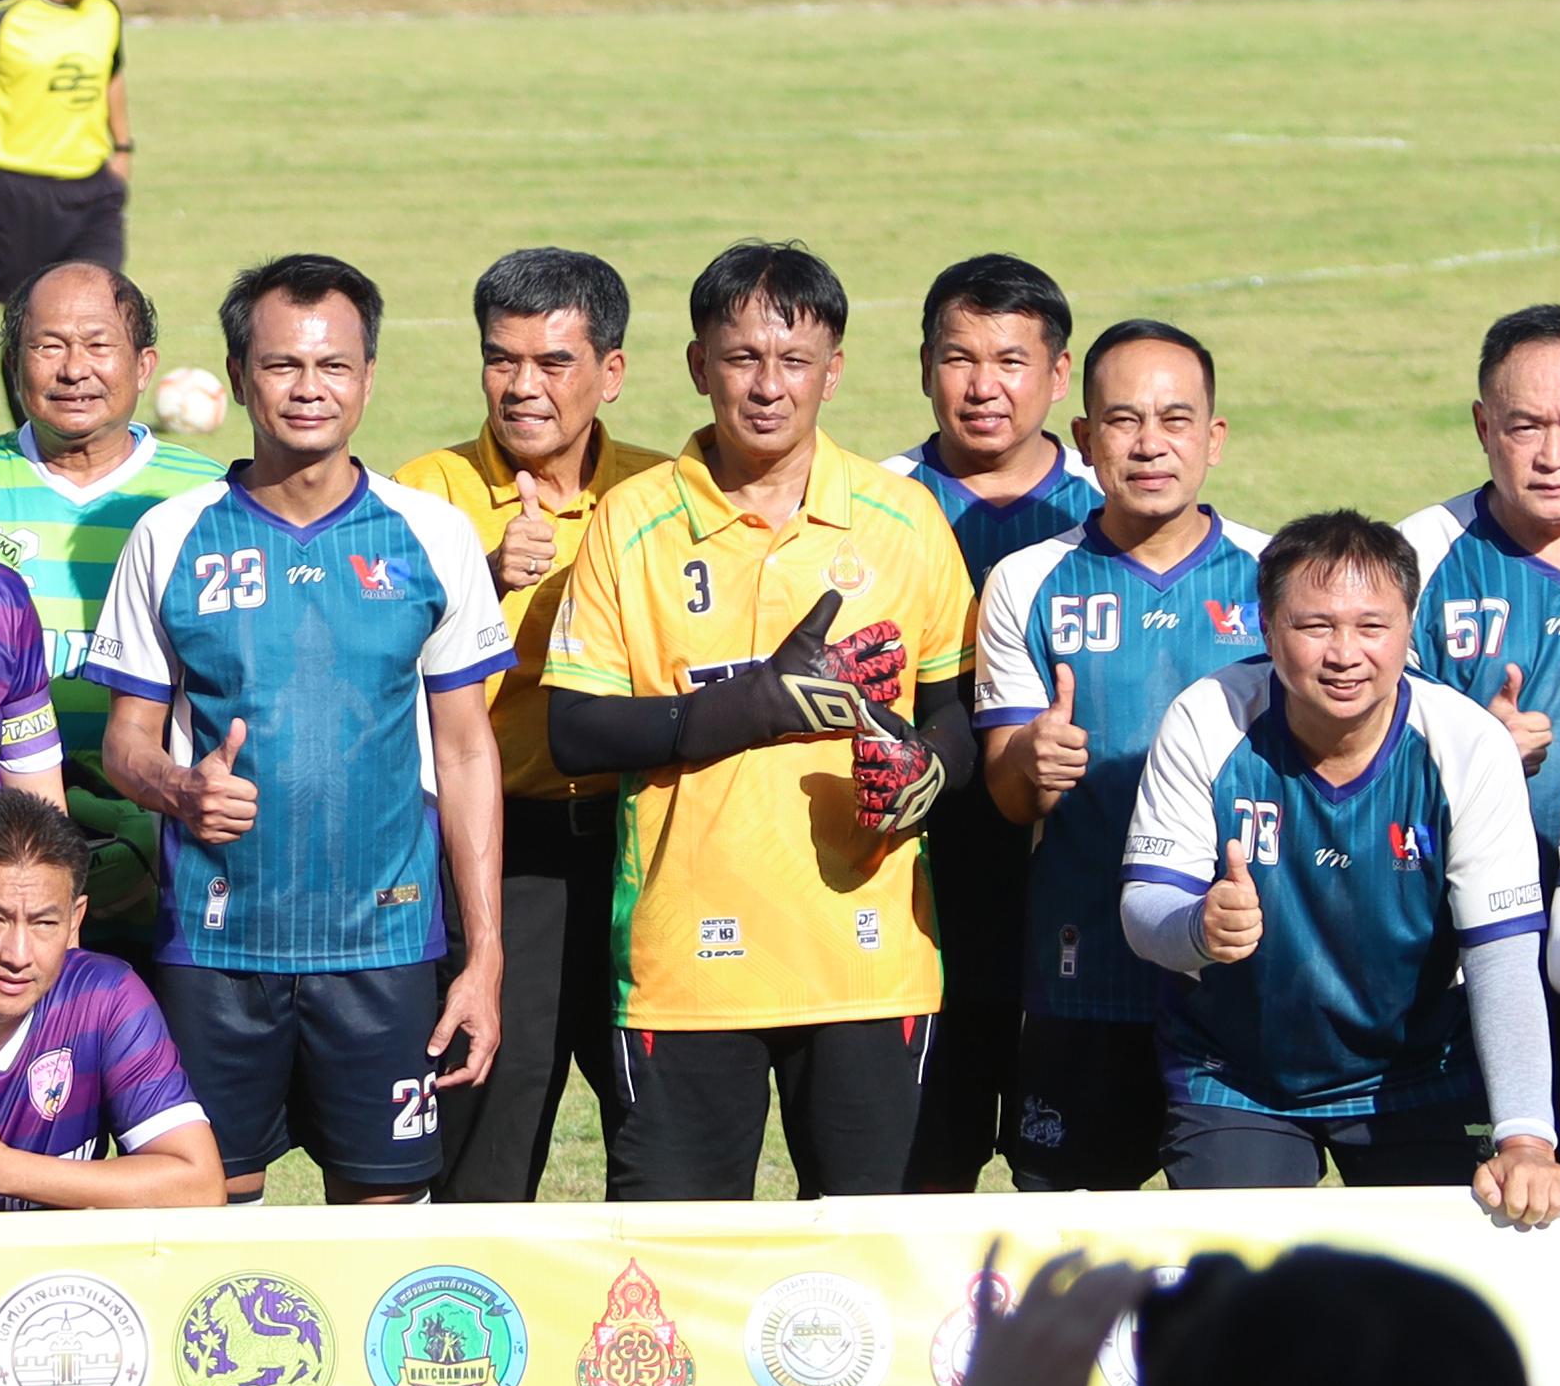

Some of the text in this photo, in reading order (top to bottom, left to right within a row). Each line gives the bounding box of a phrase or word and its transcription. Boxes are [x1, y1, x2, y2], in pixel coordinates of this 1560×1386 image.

[195, 548, 268, 616] 23
[684, 560, 711, 614] 3
[1051, 593, 1121, 655] 50
[1444, 597, 1511, 659] 57
[1488, 889, 1515, 912] VIP
